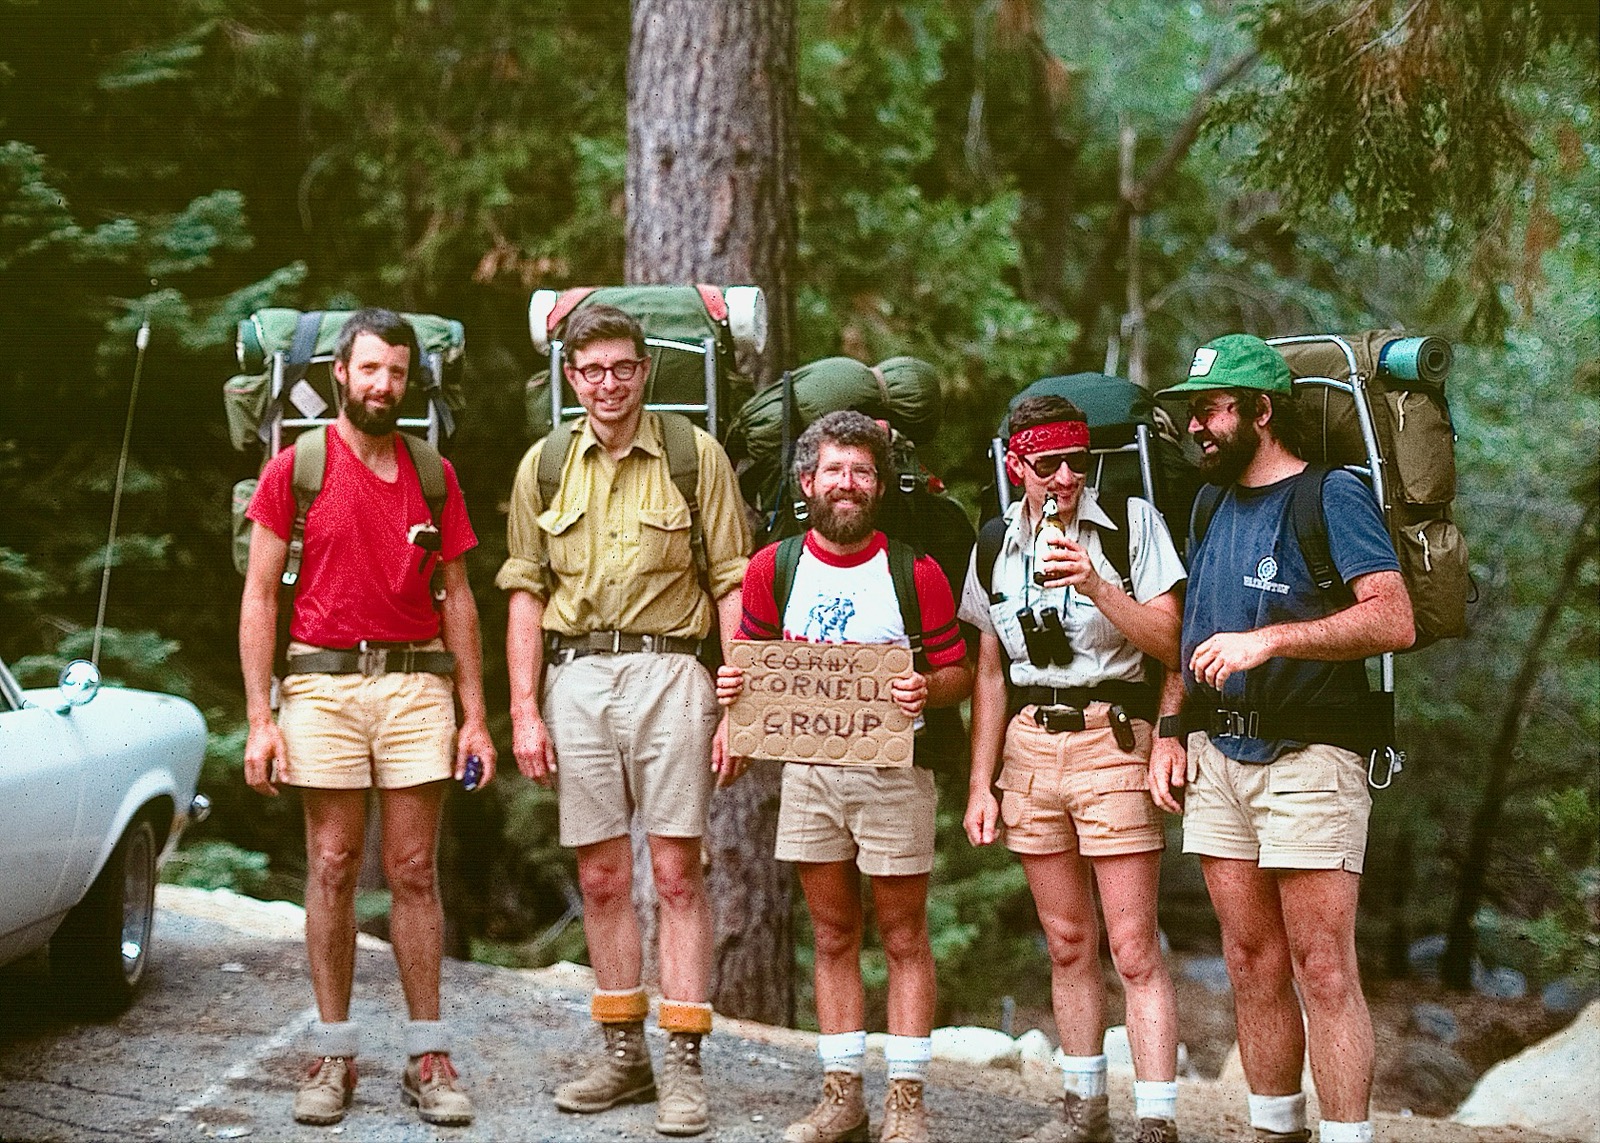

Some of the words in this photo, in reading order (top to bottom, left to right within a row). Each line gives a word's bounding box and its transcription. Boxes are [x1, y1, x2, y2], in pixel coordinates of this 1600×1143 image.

[764, 652, 858, 674] CORNY
[749, 675, 890, 702] CORNELL
[763, 712, 882, 737] GROUP
